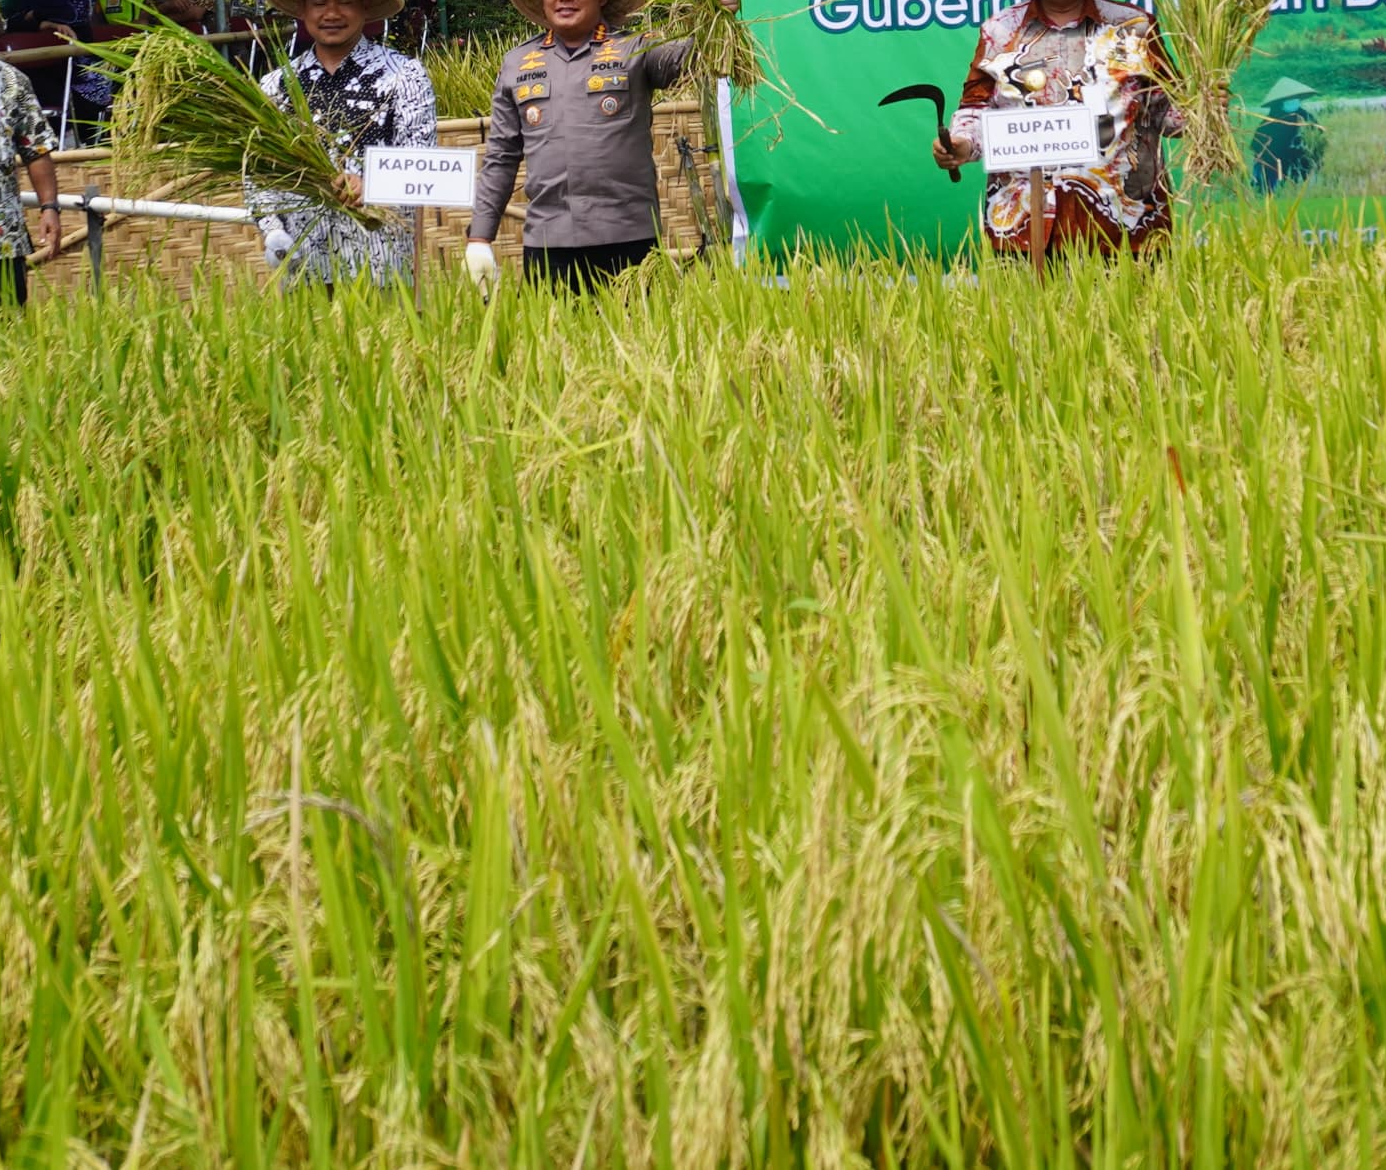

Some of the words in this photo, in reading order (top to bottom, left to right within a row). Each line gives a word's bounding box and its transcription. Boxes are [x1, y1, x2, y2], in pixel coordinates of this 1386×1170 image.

[591, 61, 626, 72] POLRI
[1007, 119, 1071, 134] BUPATI
[993, 144, 1039, 156] KULON
[1043, 141, 1090, 153] PROGO
[378, 157, 463, 172] KAPOLDA
[404, 183, 435, 196] DIY
